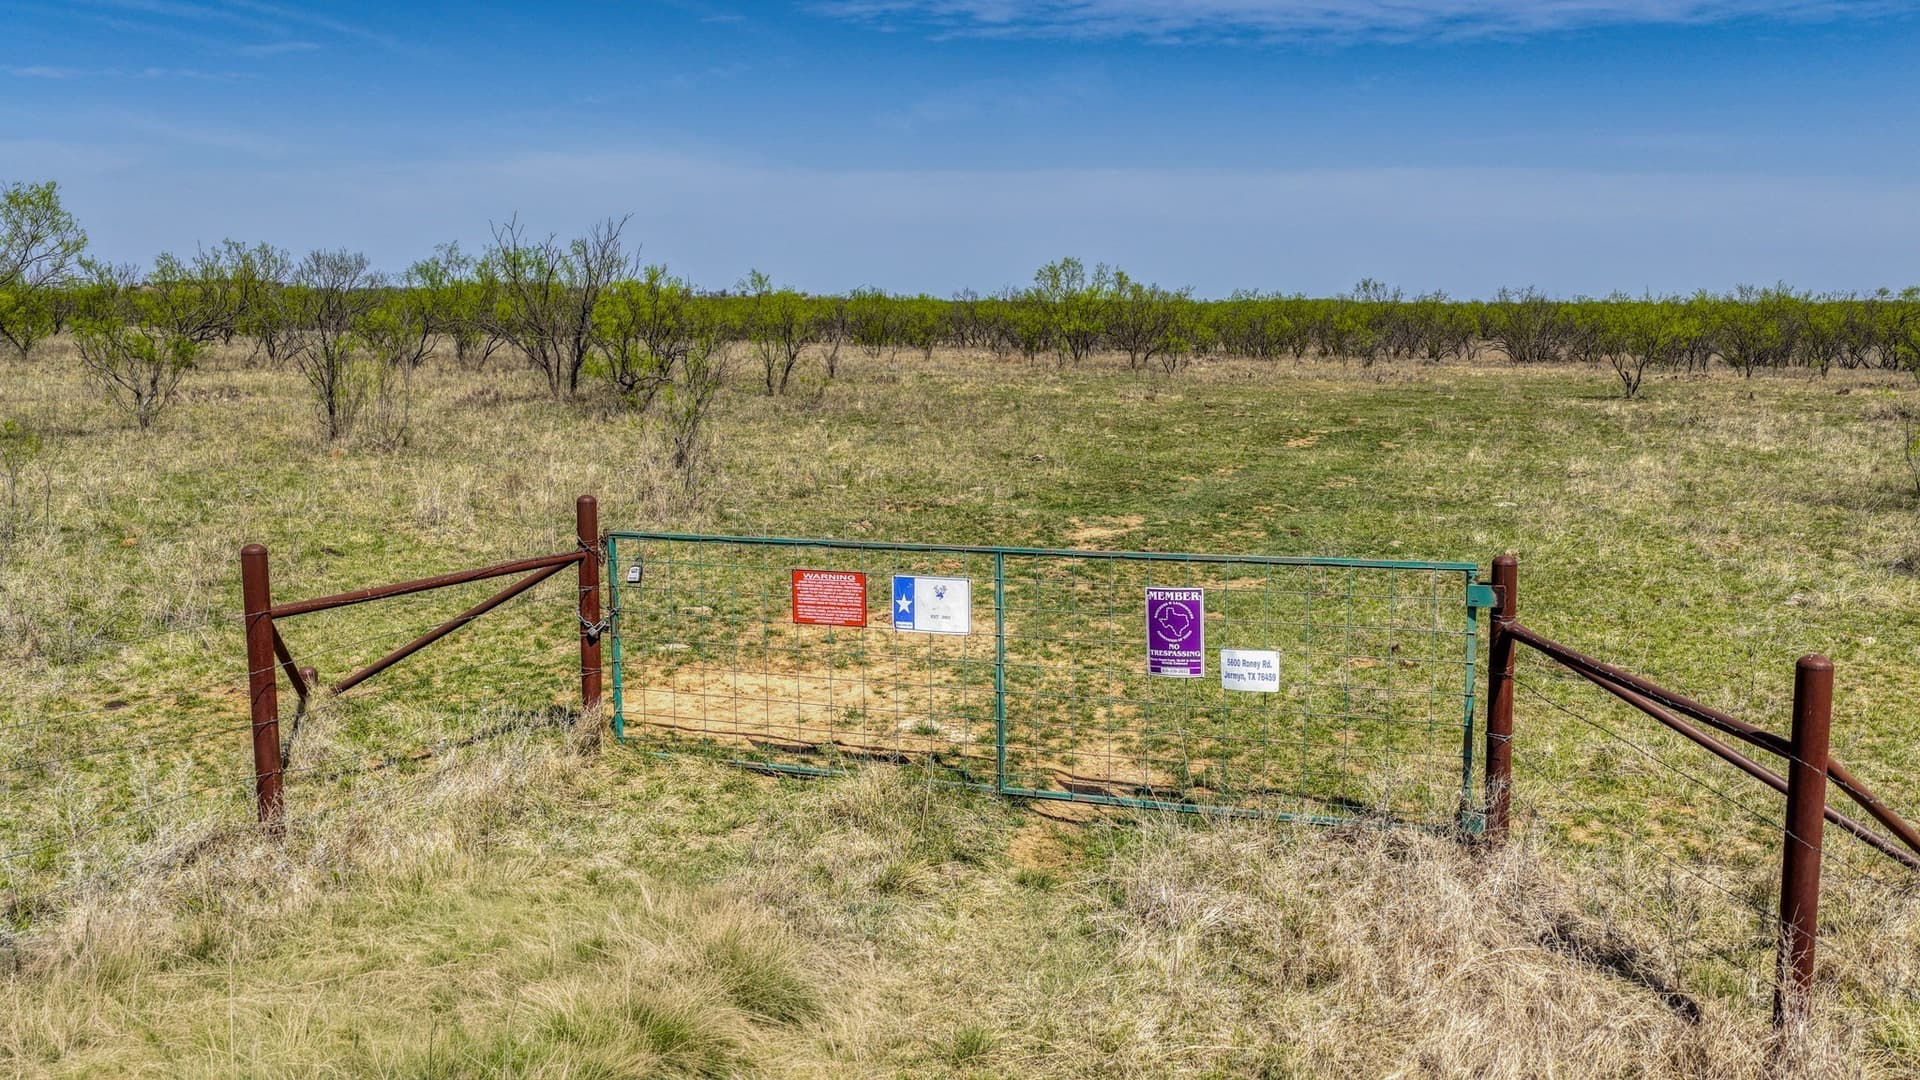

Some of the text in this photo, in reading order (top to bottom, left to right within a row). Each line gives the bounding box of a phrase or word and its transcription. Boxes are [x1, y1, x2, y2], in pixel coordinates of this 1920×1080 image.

[803, 572, 856, 581] WARNING
[1148, 591, 1200, 601] MEMBER
[1262, 660, 1273, 668] Rd.
[1248, 672, 1256, 680] TX
